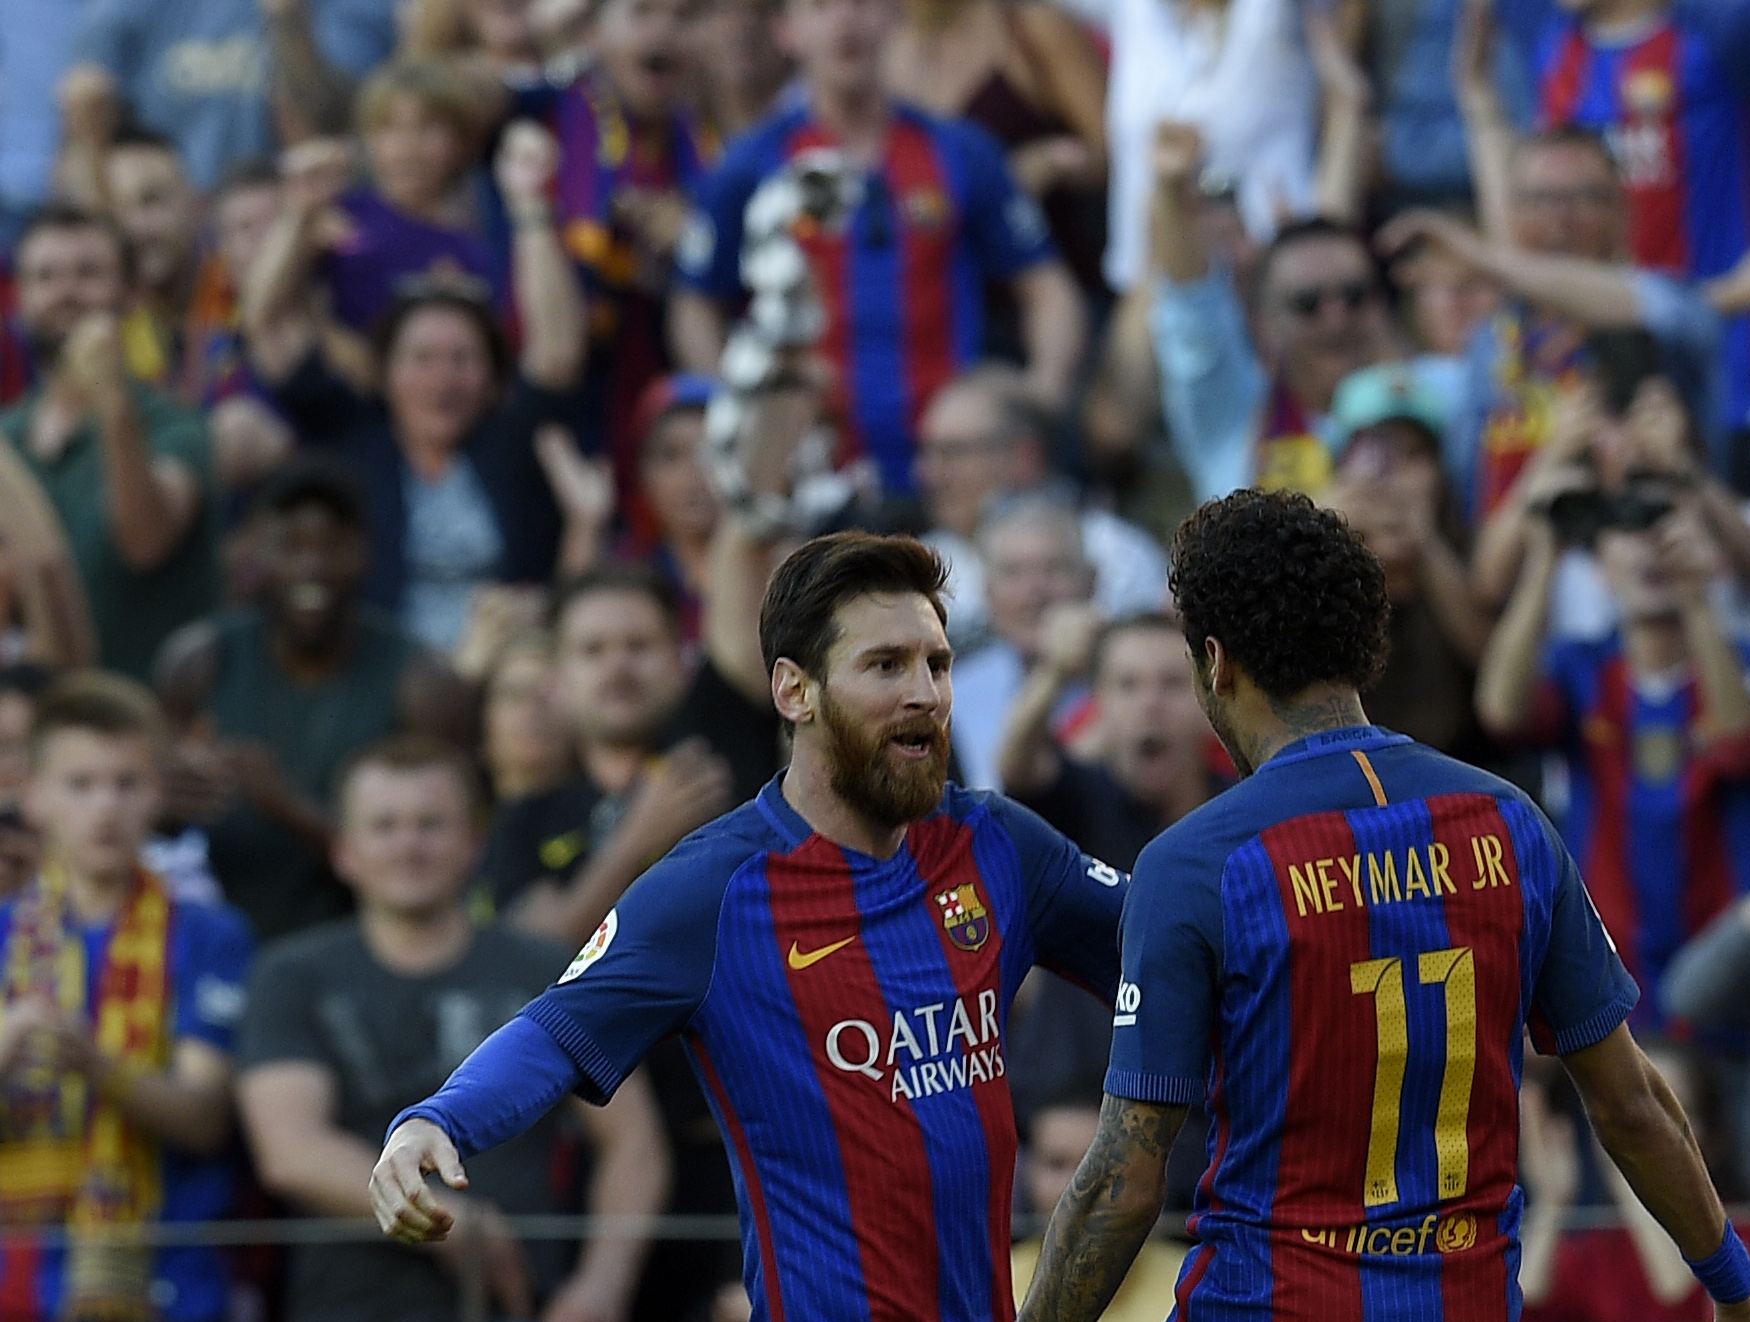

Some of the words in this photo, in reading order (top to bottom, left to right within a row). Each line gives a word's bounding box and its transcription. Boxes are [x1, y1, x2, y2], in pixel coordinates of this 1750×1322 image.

[1287, 841, 1458, 918] NEYMAR
[1470, 834, 1512, 890] JR
[825, 988, 1000, 1082] QATAR
[891, 1043, 1006, 1104] AIRWAYS
[1350, 945, 1477, 1208] 11
